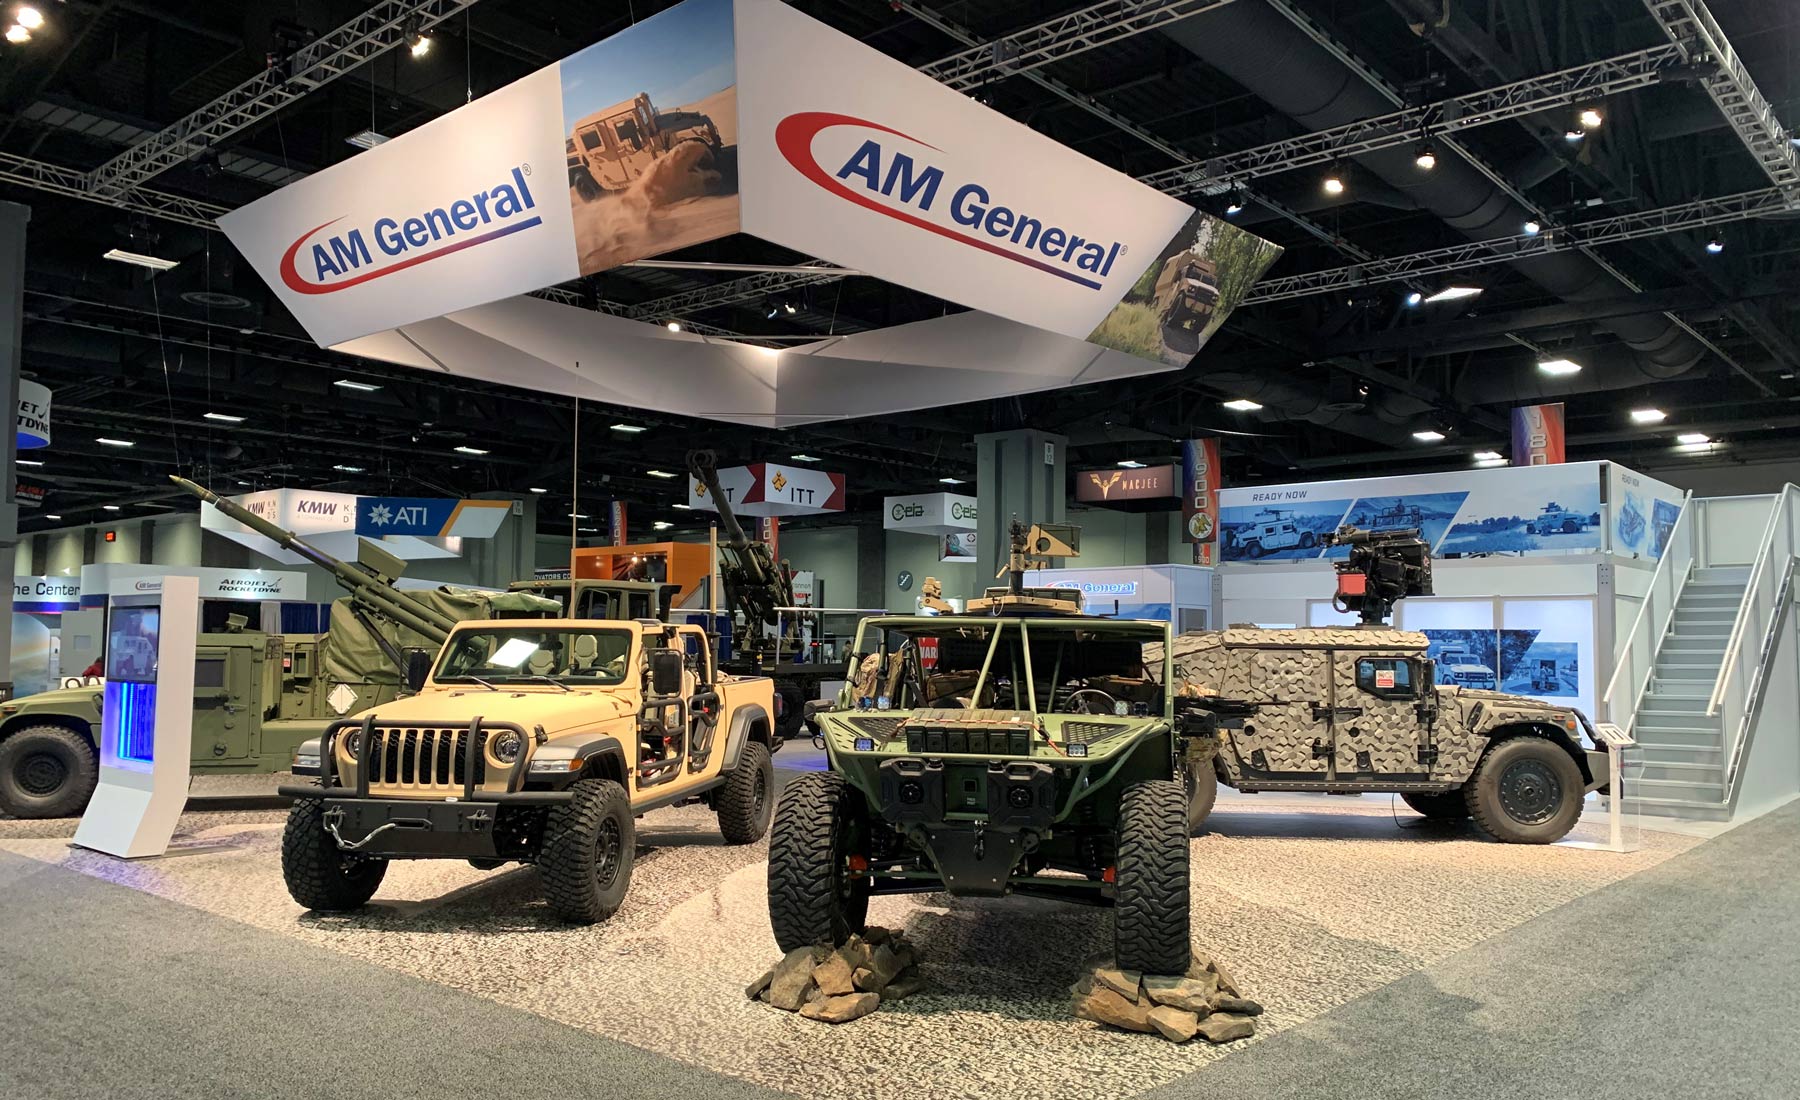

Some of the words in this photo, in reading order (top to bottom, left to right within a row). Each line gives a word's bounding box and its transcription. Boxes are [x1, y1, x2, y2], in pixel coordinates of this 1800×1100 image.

[835, 139, 945, 212] AM
[311, 228, 374, 282] AM
[791, 487, 815, 504] ITT
[1252, 492, 1283, 501] READY
[1285, 490, 1308, 499] NOW
[247, 501, 266, 514] KMW
[297, 500, 337, 515] KMW
[393, 507, 427, 526] ATI
[35, 582, 80, 596] Center
[218, 585, 281, 593] ROCKETDYNE
[220, 578, 267, 587] AEROJET
[1083, 582, 1135, 594] General
